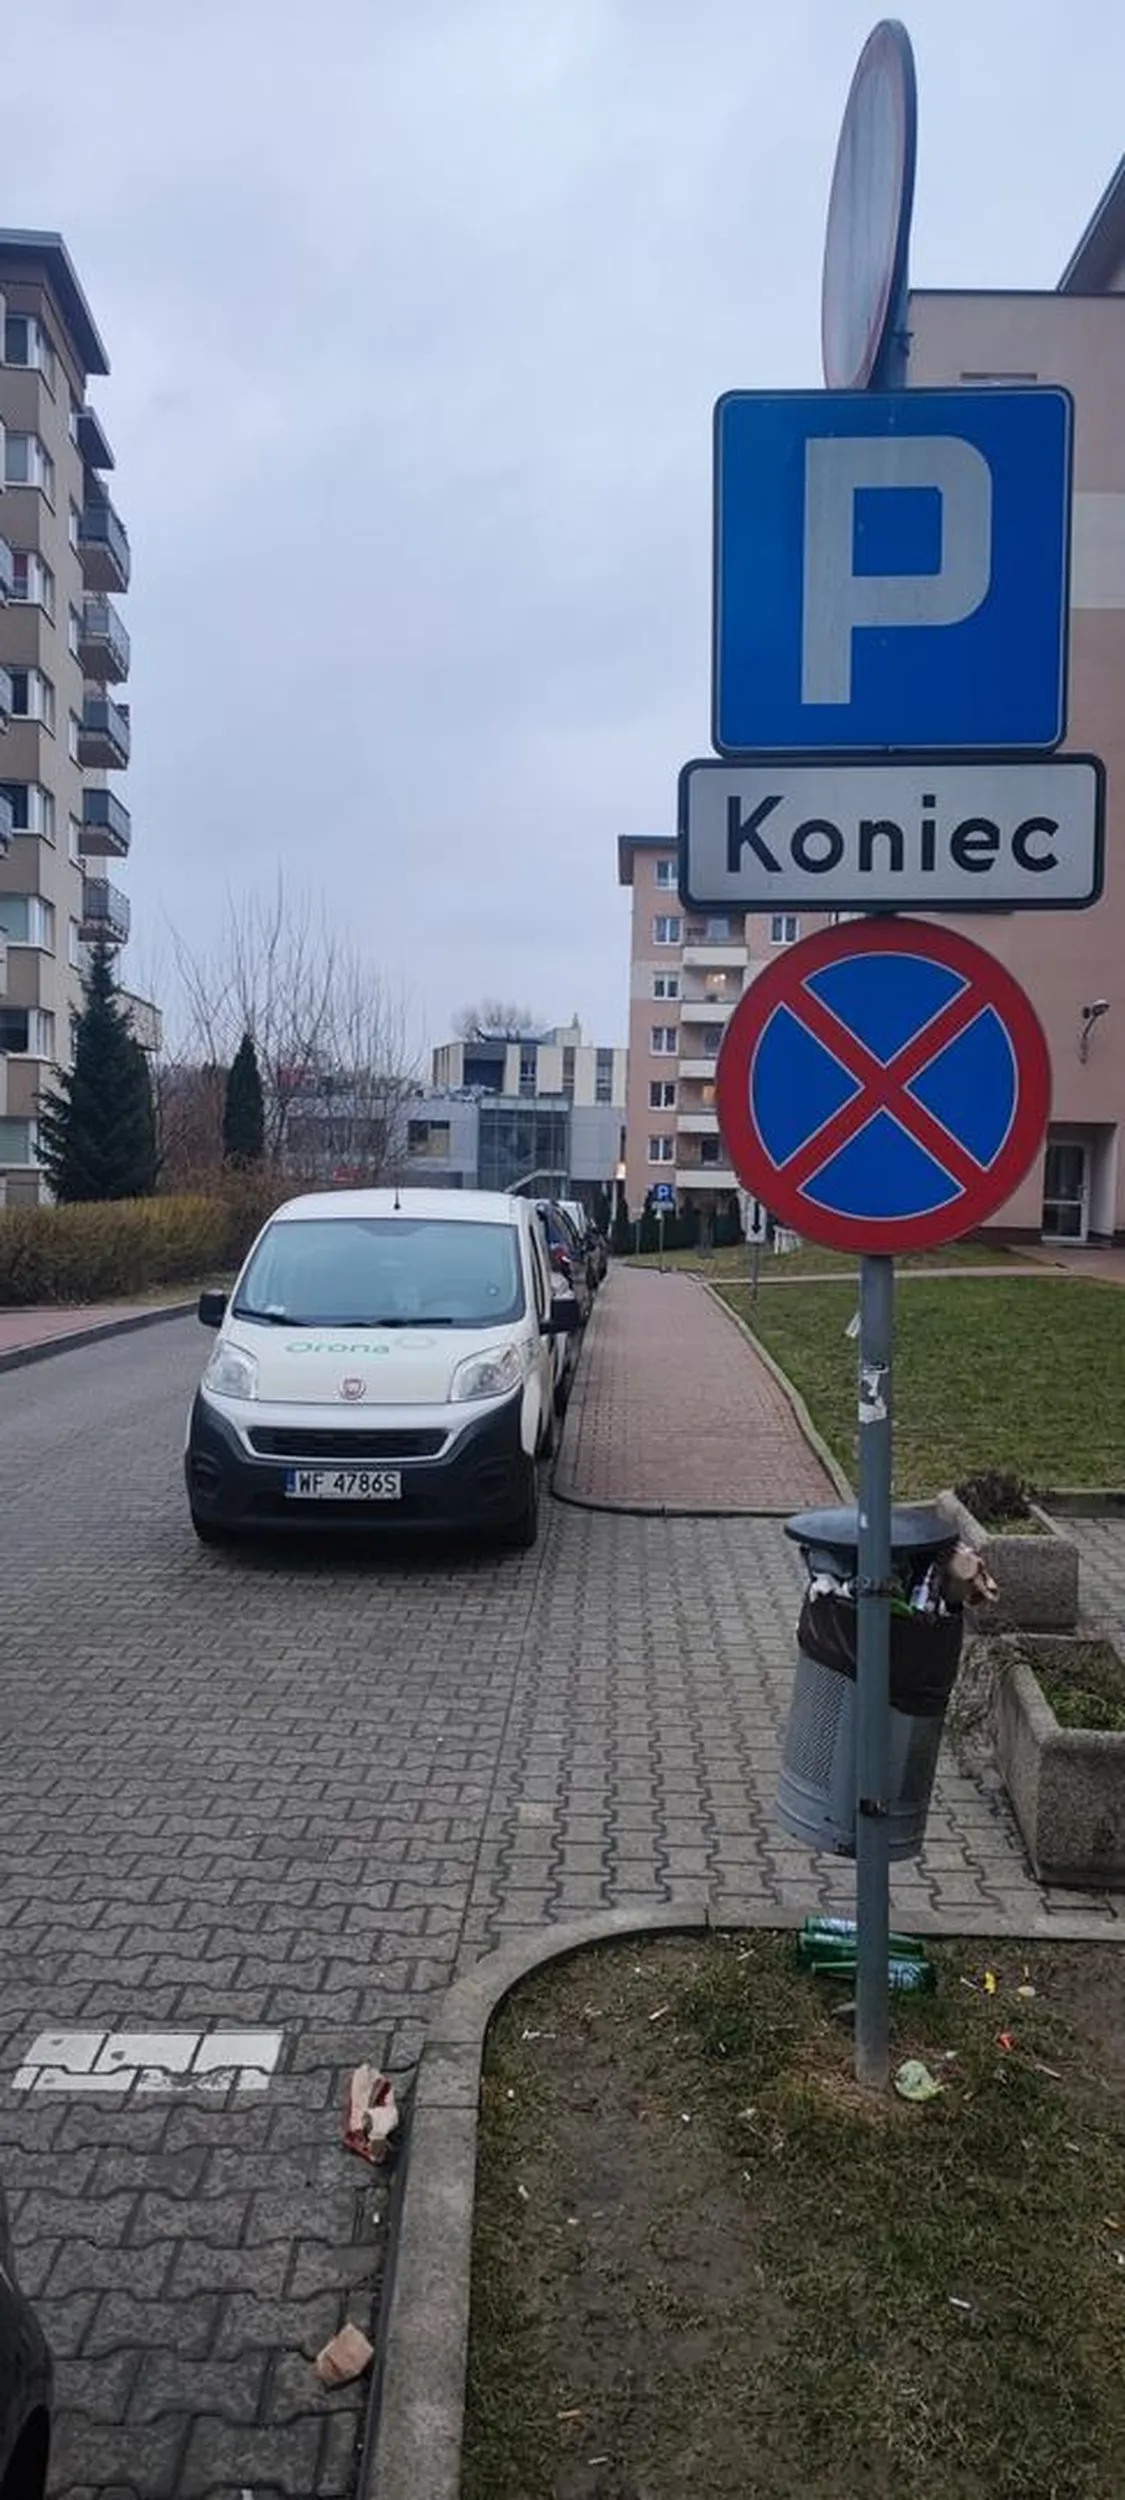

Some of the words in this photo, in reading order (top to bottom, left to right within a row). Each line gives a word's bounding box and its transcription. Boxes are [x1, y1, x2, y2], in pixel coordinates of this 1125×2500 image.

[801, 436, 993, 705] P
[726, 794, 1060, 874] Koniec
[657, 1184, 669, 1200] P
[300, 1473, 324, 1492] WF
[333, 1473, 397, 1493] 4786S
